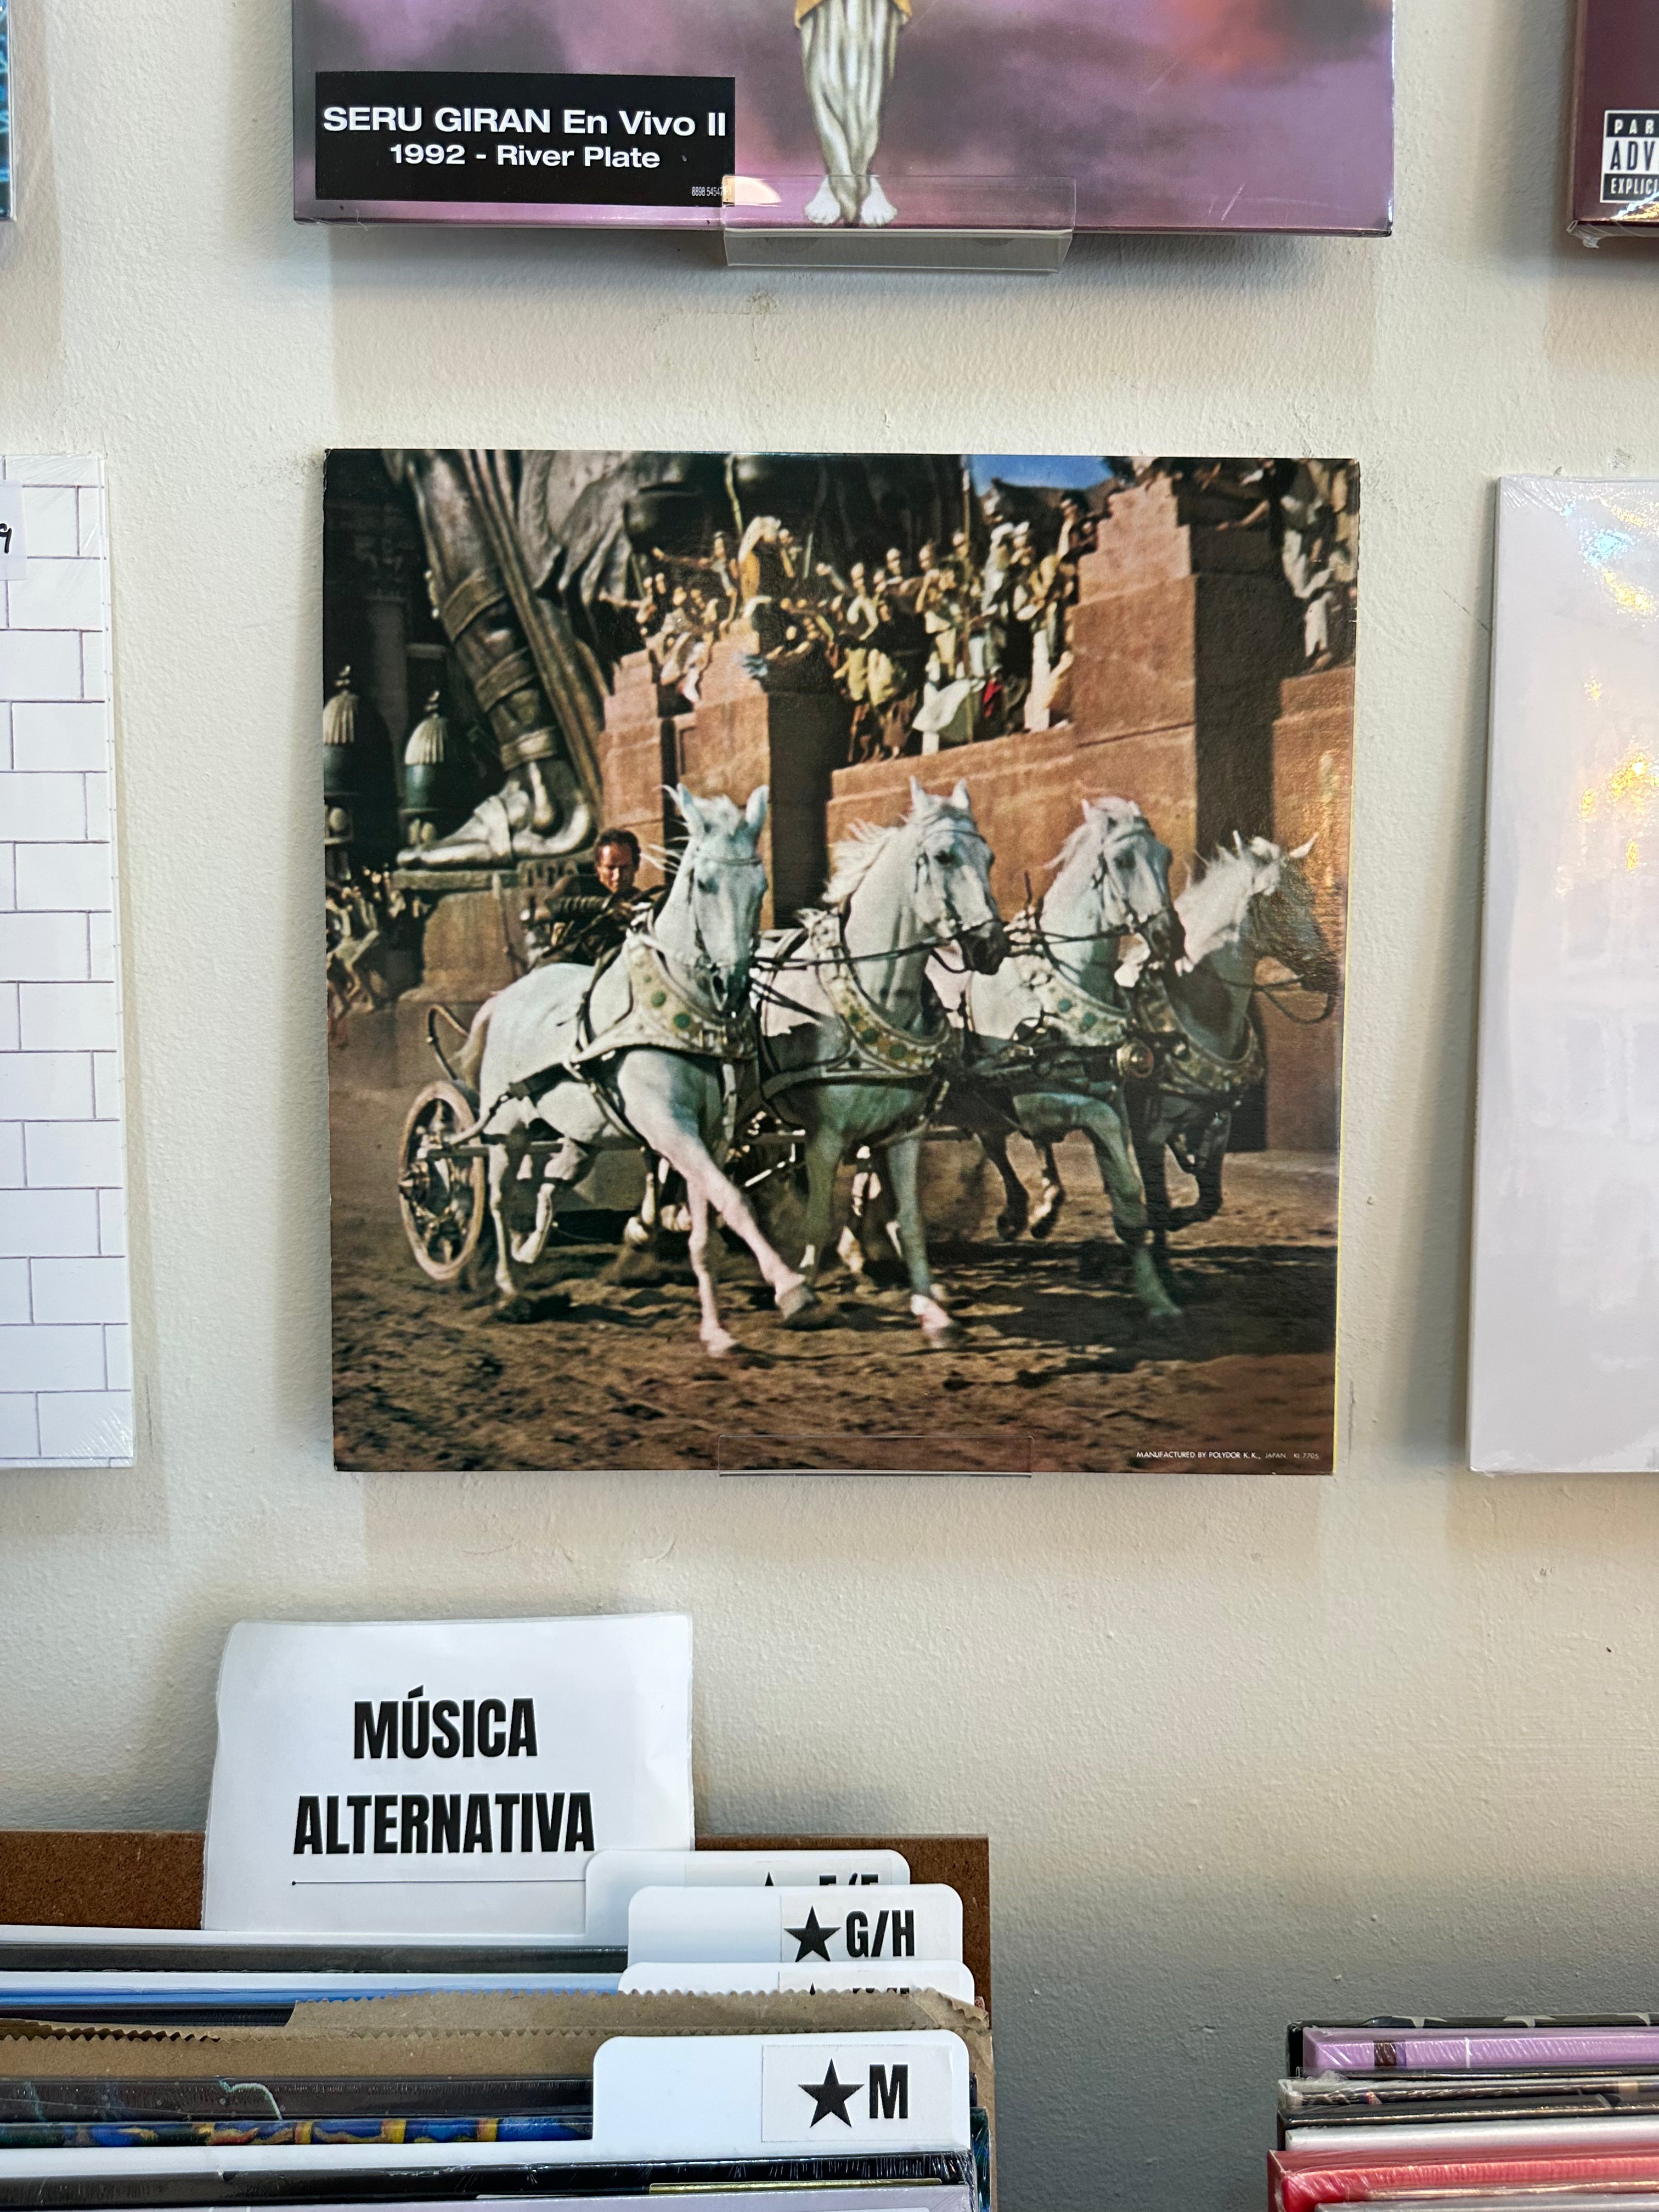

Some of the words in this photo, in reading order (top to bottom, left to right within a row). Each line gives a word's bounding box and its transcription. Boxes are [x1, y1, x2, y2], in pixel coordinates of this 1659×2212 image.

[324, 107, 422, 132] SERU
[435, 108, 550, 133] GIRAN
[563, 109, 607, 134] En
[619, 111, 696, 136] Vivo
[708, 112, 726, 136] II
[390, 144, 465, 165] 1992
[497, 145, 574, 166] River
[584, 146, 660, 168] Plate
[692, 187, 706, 196] 8898
[354, 1685, 538, 1759] MÚSICA
[294, 1792, 595, 1854] ALTERNATIVA
[846, 1910, 915, 1957] G/H
[869, 2064, 909, 2119] M
